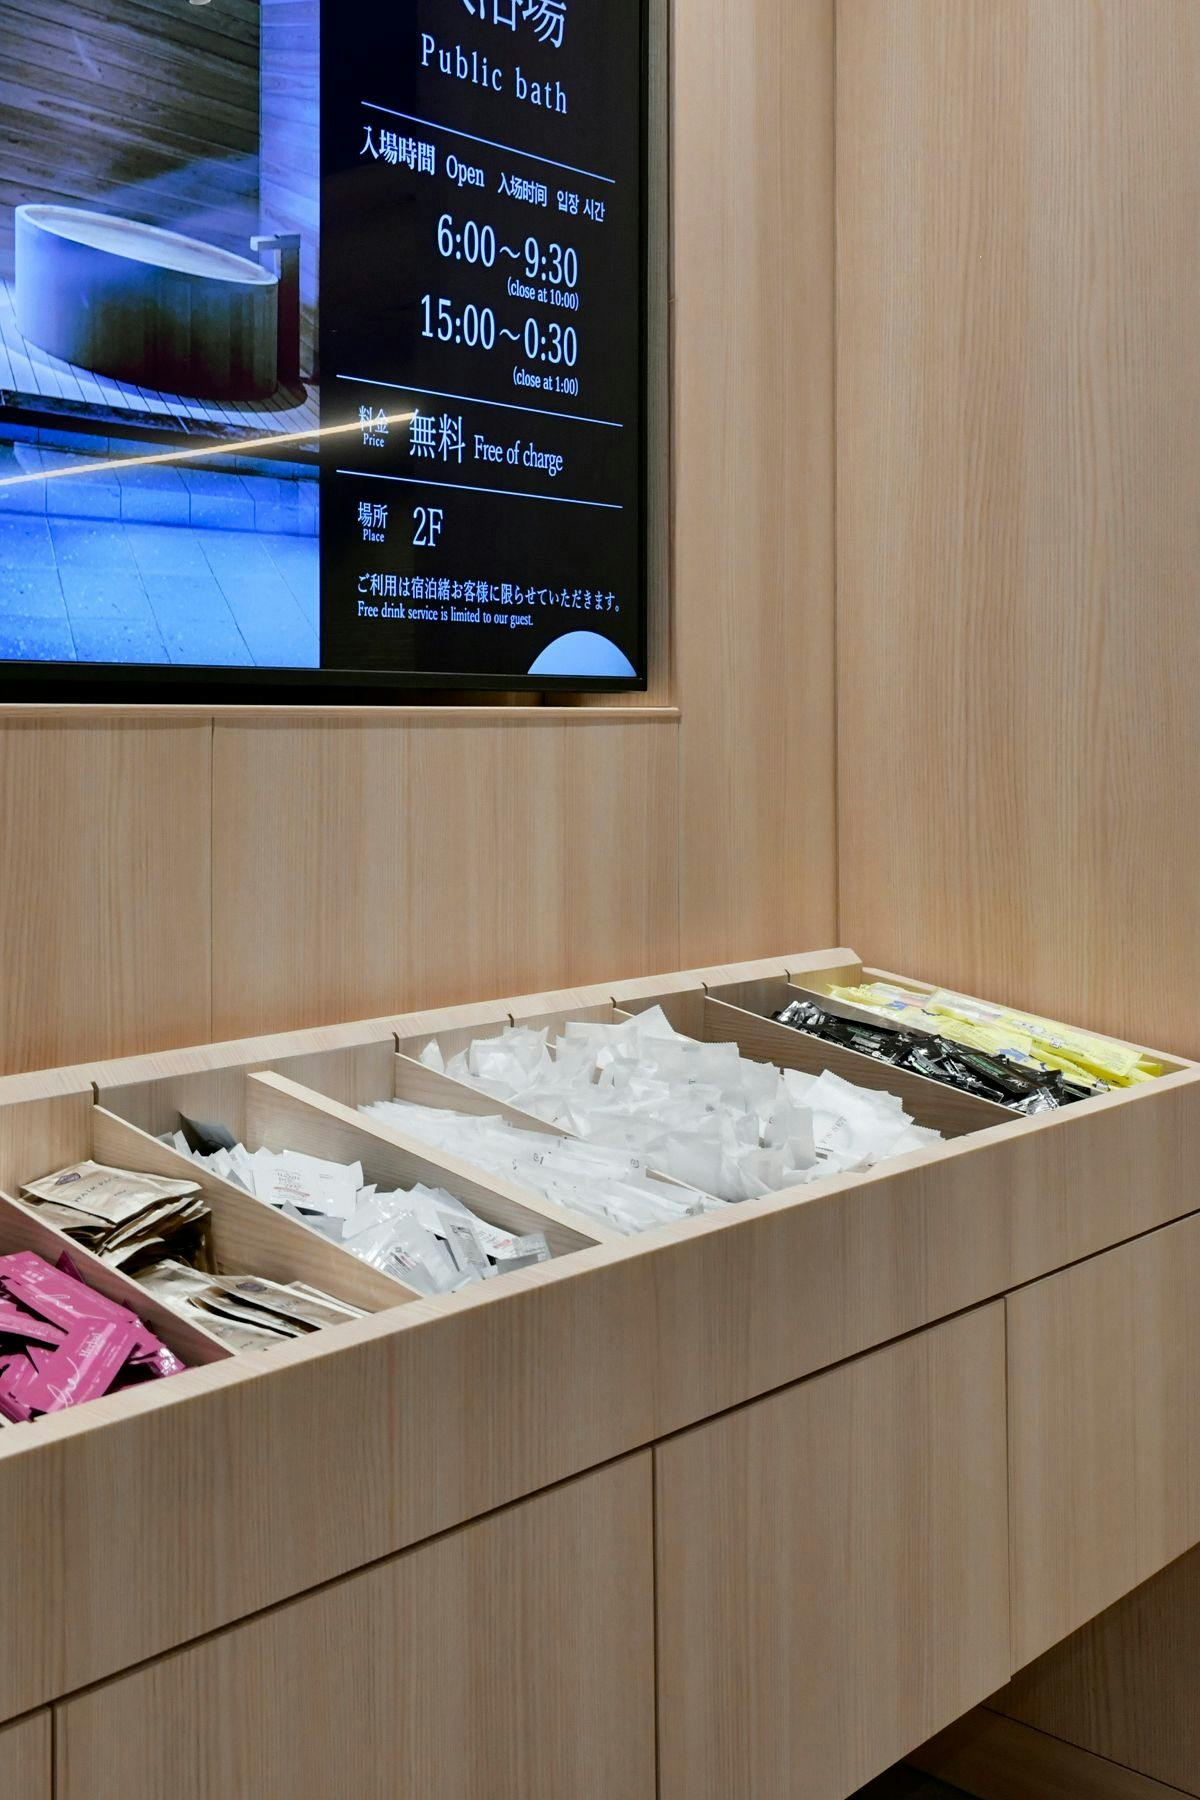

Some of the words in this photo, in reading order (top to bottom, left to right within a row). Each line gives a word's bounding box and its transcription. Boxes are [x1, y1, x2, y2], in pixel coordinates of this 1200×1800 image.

[421, 33, 503, 92] Public
[515, 67, 568, 114] bath
[359, 125, 436, 176] 入場時間
[445, 154, 486, 188] Open
[497, 171, 548, 208] 入场时间
[556, 190, 580, 215] 입장
[583, 201, 606, 223] 시간
[507, 276, 536, 300] (close
[537, 287, 548, 303] at
[549, 289, 579, 311] 10:00)
[513, 365, 541, 388] (close
[542, 375, 553, 390] at
[555, 376, 579, 397] 1:00)
[358, 405, 389, 435] 料金
[408, 408, 466, 464] 無料
[363, 432, 385, 448] Price
[473, 434, 503, 464] Free
[506, 440, 521, 465] of
[523, 444, 564, 476] charge
[357, 501, 389, 530] 場所
[412, 506, 444, 547] 2F
[363, 528, 385, 543] Place
[357, 600, 379, 618] Free
[381, 601, 406, 619] drink
[408, 604, 439, 621] service
[440, 606, 449, 621] is
[450, 606, 480, 623] limited
[482, 612, 492, 624] to
[493, 614, 508, 624] our
[510, 614, 534, 629] guest.
